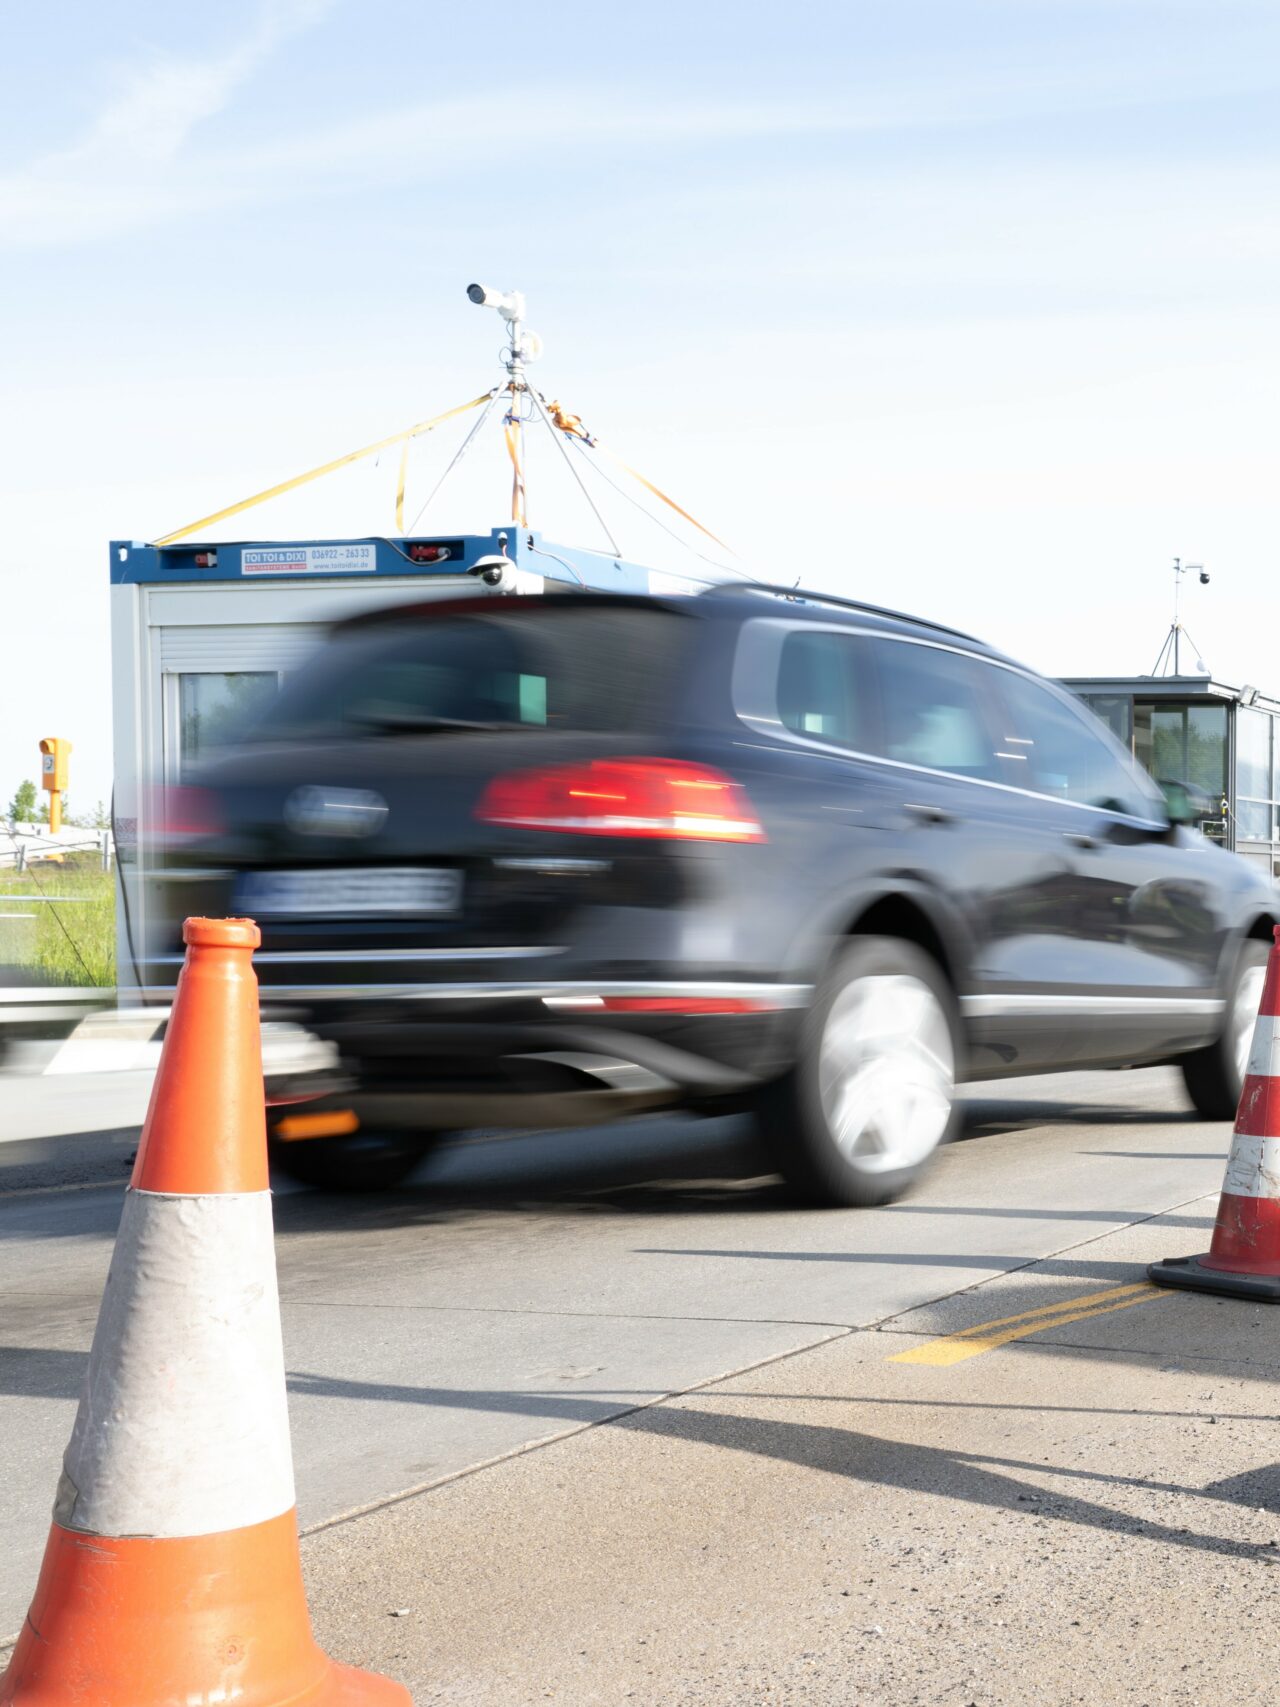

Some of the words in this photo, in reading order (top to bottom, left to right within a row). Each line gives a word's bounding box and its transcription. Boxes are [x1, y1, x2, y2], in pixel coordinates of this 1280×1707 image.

[246, 553, 261, 562] TOI
[262, 552, 278, 562] TOI
[286, 551, 305, 561] DIXI
